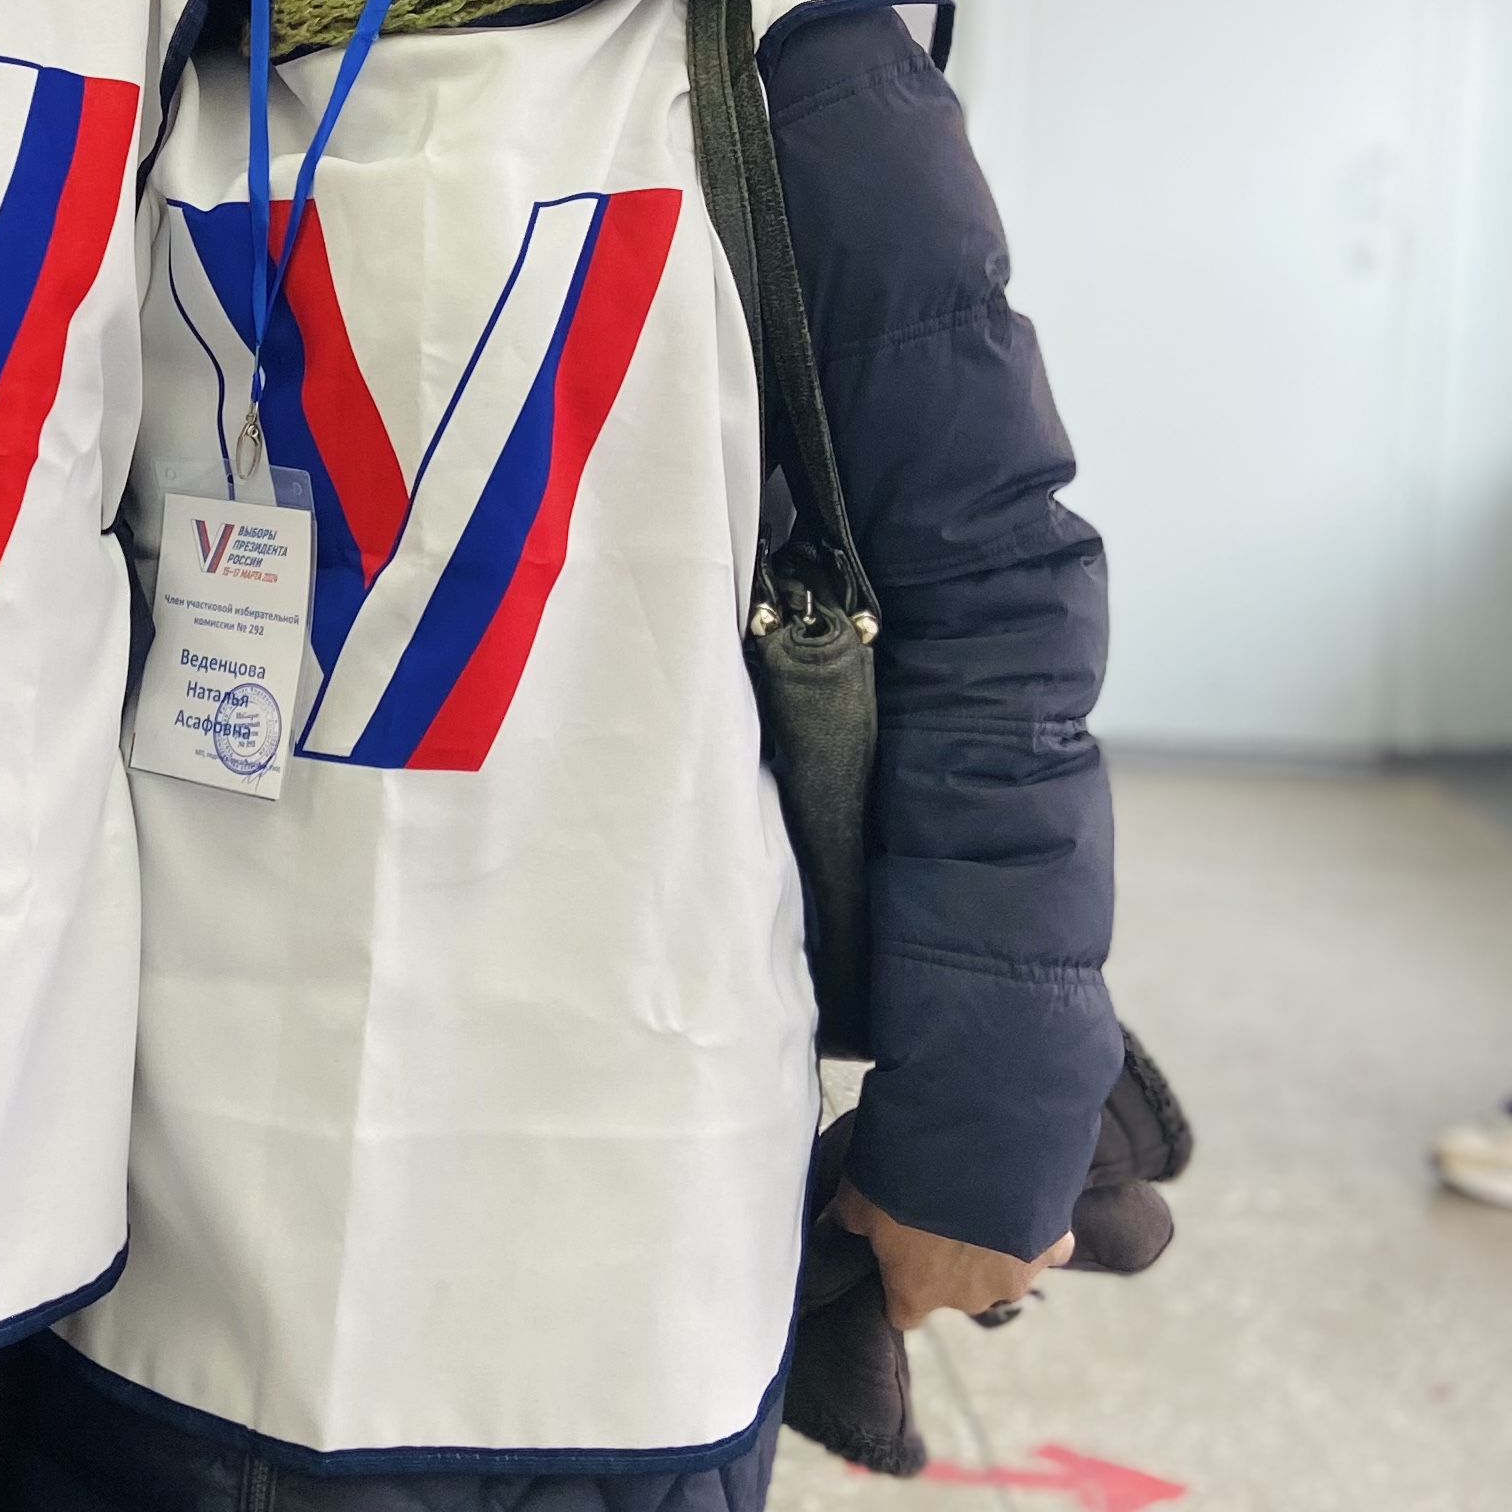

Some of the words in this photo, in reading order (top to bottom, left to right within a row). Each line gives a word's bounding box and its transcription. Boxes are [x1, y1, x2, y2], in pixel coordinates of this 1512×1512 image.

[238, 526, 277, 540] ВЫБОРЫ
[232, 540, 288, 556] ПРЕЗИДЕНТА
[227, 553, 263, 567] РОССИИ
[240, 569, 262, 581] МАРТА
[165, 593, 184, 606] Член
[186, 599, 233, 613] участковой
[234, 607, 299, 624] избирательной
[193, 616, 235, 630] комиссии
[236, 622, 247, 633] №
[248, 624, 264, 635] 292
[180, 648, 266, 679] Веденцова
[186, 680, 249, 708] Наталья
[174, 709, 251, 740] Асафовна
